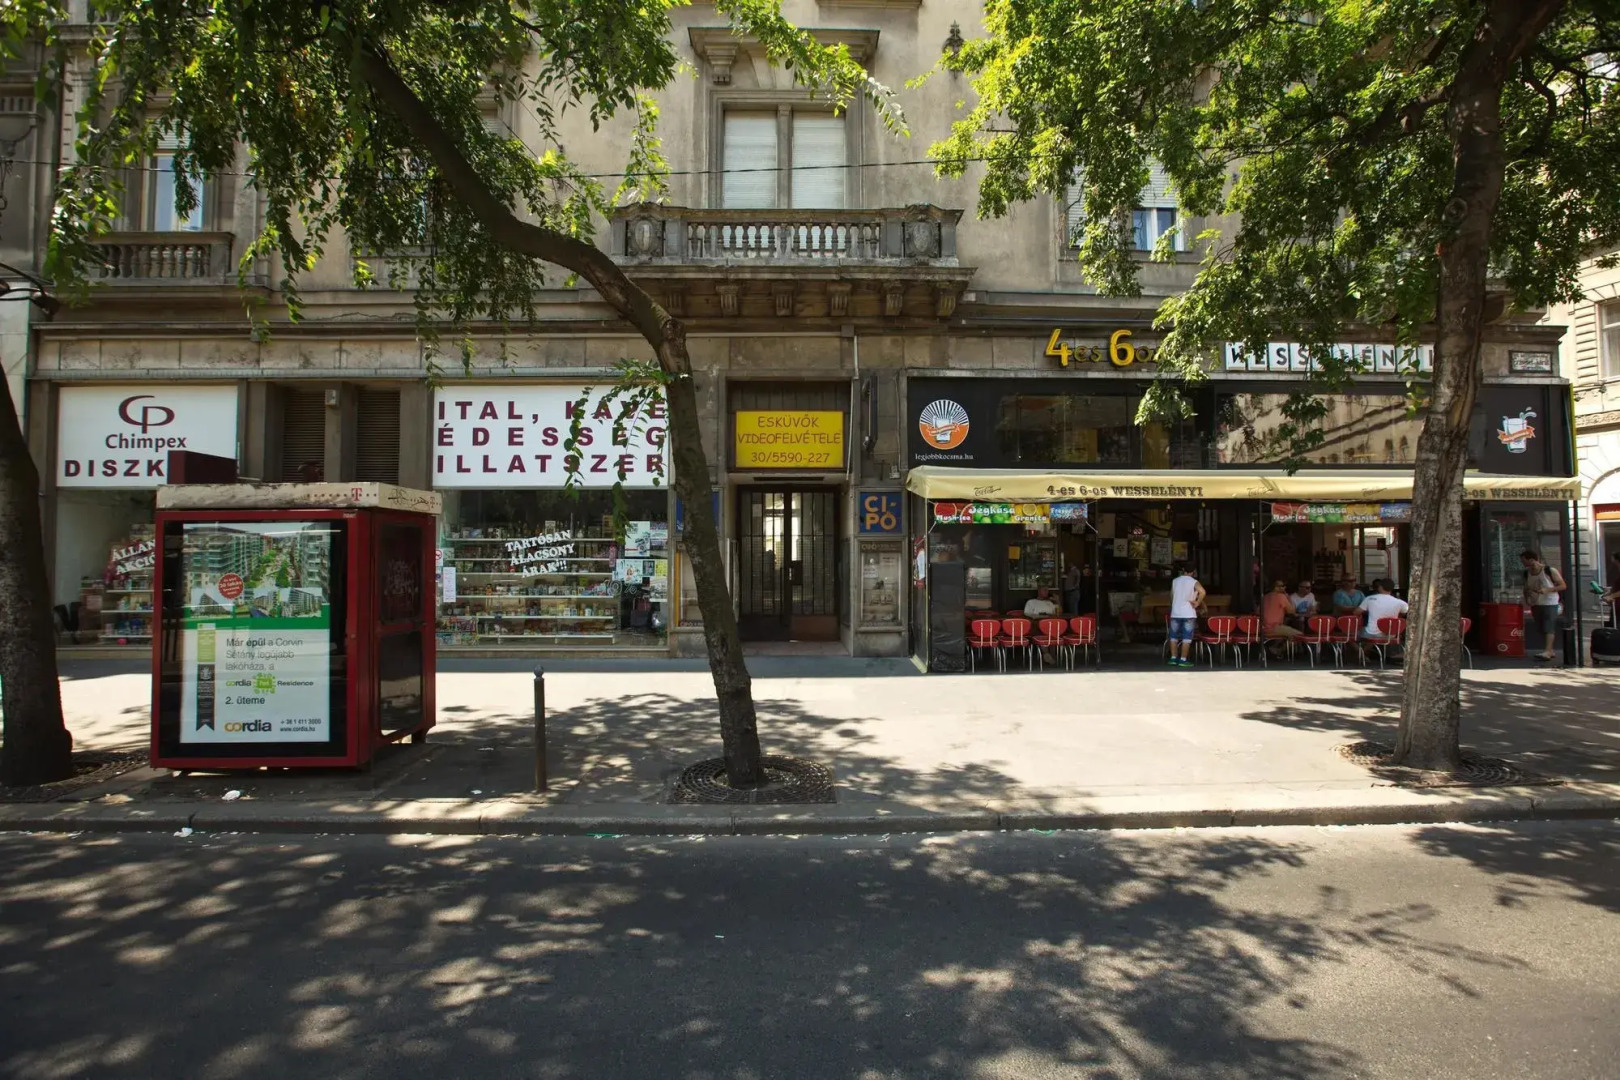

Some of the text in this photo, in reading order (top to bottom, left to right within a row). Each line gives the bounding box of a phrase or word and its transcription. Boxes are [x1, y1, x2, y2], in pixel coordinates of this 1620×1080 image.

[1109, 329, 1159, 366] 6o
[437, 400, 539, 424] ITAL,
[757, 414, 820, 428] ESKÜVŐK
[105, 433, 188, 452] Chimpex
[737, 430, 841, 445] VIDEOFELVÉTELE
[437, 454, 665, 473] ILLATSZER
[751, 452, 831, 464] 30/5590-227
[915, 453, 974, 462] legjobbkocsma.hu
[64, 459, 166, 477] DISZK
[351, 488, 362, 501] T
[1111, 483, 1204, 497] WESSELÉNYI
[1490, 486, 1575, 499] WESSELÉNYI
[505, 529, 572, 552] TARTÓSAN
[112, 539, 155, 562] ÁLLAN
[510, 543, 575, 566] ALACSONY
[226, 638, 244, 647] Már
[246, 638, 265, 649] épül
[275, 637, 303, 647] Corvin
[226, 649, 255, 660] Sétány
[226, 679, 252, 687] cordia
[225, 695, 265, 705] 2. üteme
[224, 719, 272, 732] cordia
